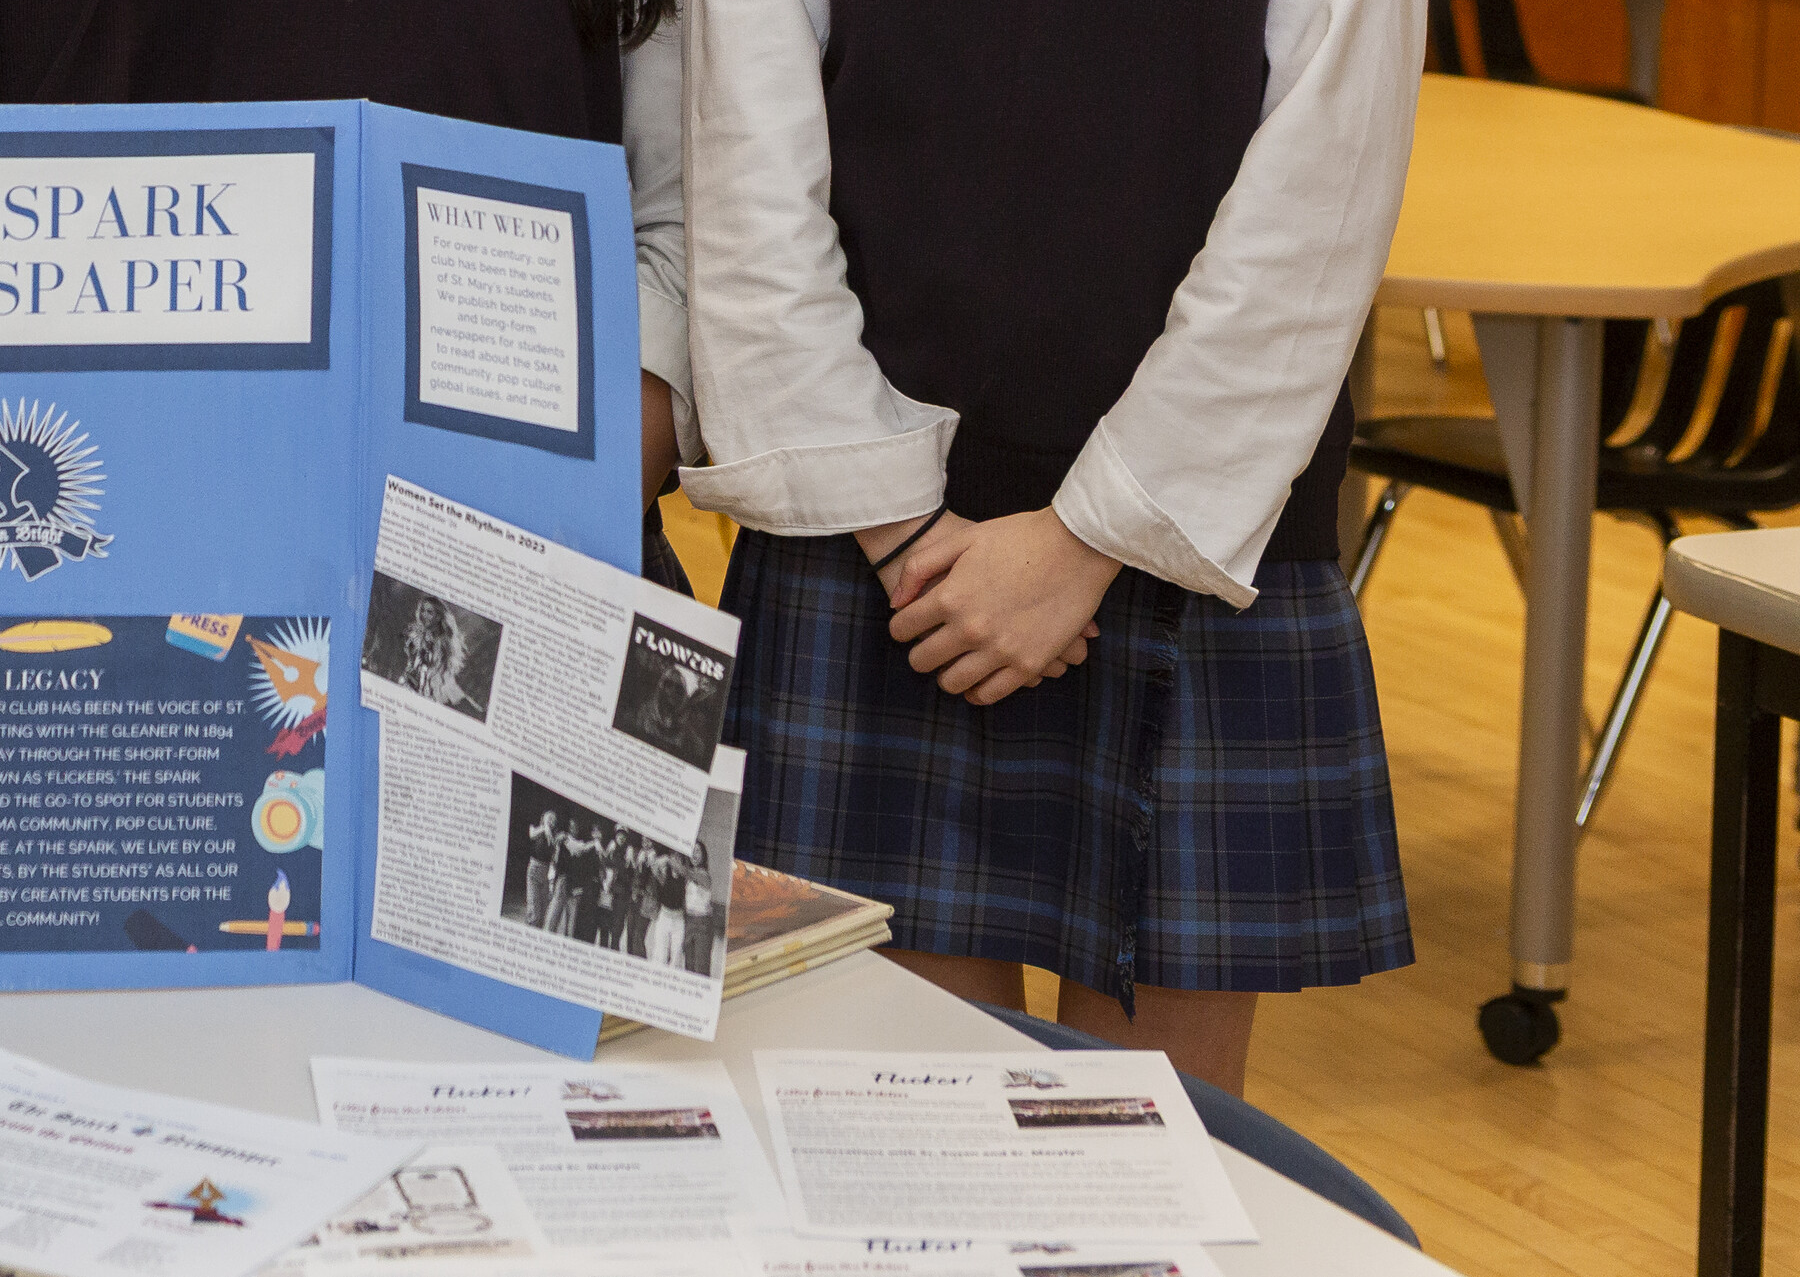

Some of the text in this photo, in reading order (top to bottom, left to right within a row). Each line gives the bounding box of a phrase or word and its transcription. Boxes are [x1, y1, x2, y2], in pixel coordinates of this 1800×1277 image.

[2, 183, 239, 239] SPARK
[427, 202, 559, 244] WHAT WE DO
[433, 236, 451, 248] For
[454, 241, 478, 253] over
[481, 246, 488, 255] a
[537, 256, 556, 266] our
[431, 254, 561, 286] club has been the voice
[437, 272, 448, 283] of
[451, 273, 462, 286] St.
[468, 277, 501, 294] Mary's
[436, 288, 558, 321] We publish both short
[457, 313, 536, 335] and long-form
[430, 325, 565, 358] newspapers for students
[436, 342, 559, 374] to read about the SMA
[497, 373, 519, 386] pop
[429, 377, 464, 392] global
[506, 394, 527, 405] and
[387, 479, 426, 502] Women
[428, 497, 444, 511] Set
[446, 505, 462, 519] the
[465, 513, 503, 539] Rhythm
[505, 530, 516, 542] in
[518, 535, 546, 555] 2023
[15, 524, 64, 546] Bright
[180, 615, 229, 638] PRESS
[634, 626, 726, 681] FLOWERS
[5, 668, 104, 691] LEGACY
[8, 700, 49, 716] CLUB
[51, 699, 81, 715] HAS
[84, 699, 122, 715] BEEN
[126, 699, 154, 715] THE
[158, 699, 200, 715] VOICE
[203, 699, 223, 715] OF
[226, 699, 247, 715] ST.
[35, 723, 75, 738] WITH
[184, 722, 200, 738] IN
[202, 724, 234, 740] 1894
[20, 746, 90, 762] THROUGH
[93, 746, 121, 762] THE
[124, 746, 220, 761] SHORT-FORM
[23, 770, 42, 785] AS
[123, 769, 152, 784] THE
[155, 769, 201, 784] SPARK
[14, 793, 41, 808] THE
[44, 793, 92, 808] GO-TO
[95, 793, 132, 808] SPOT
[136, 793, 165, 808] FOR
[168, 793, 244, 808] STUDENTS
[19, 816, 112, 831] COMMUNITY,
[115, 815, 145, 831] POP
[148, 815, 218, 831] CULTURE,
[15, 840, 33, 855] AT
[37, 840, 65, 855] THE
[121, 839, 144, 854] WE
[148, 839, 178, 854] LIVE
[182, 839, 201, 854] BY
[205, 839, 236, 854] OUR
[18, 863, 36, 878] BY
[40, 863, 68, 878] THE
[155, 863, 174, 878] AS
[177, 863, 204, 878] ALL
[207, 863, 238, 878] OUR
[0, 887, 17, 902] BY
[21, 886, 89, 902] CREATIVE
[93, 886, 169, 901] STUDENTS
[172, 886, 200, 901] FOR
[204, 886, 231, 901] THE
[6, 911, 100, 926] COMMUNITY!
